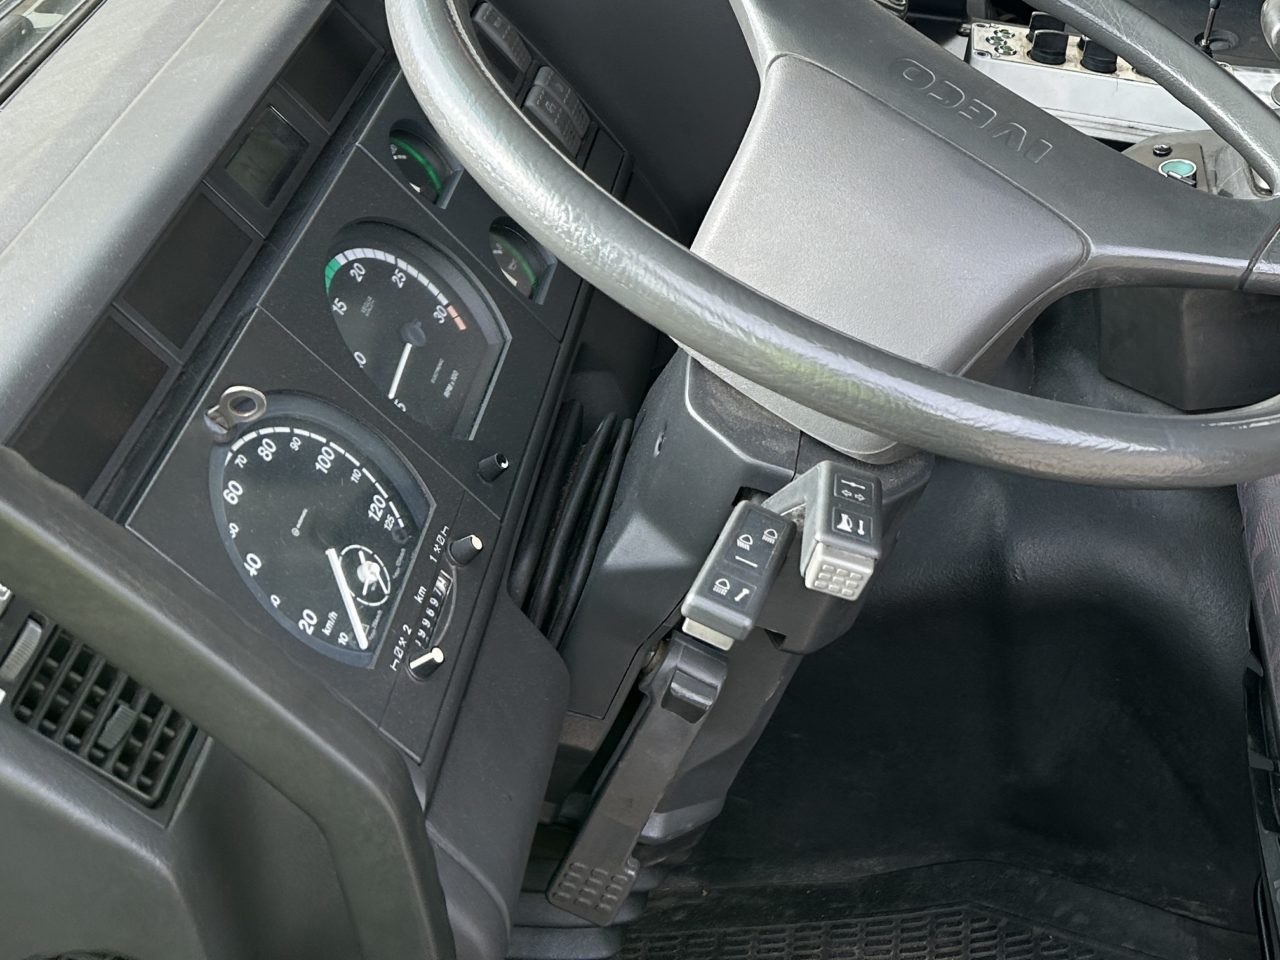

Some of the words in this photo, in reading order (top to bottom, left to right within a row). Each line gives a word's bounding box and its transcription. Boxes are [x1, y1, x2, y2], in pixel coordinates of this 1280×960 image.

[895, 58, 1053, 164] IVECO
[350, 263, 366, 283] 20
[392, 269, 407, 289] 25
[331, 297, 347, 315] 15
[433, 305, 449, 324] 30
[353, 351, 367, 368] 0
[394, 398, 407, 412] 5
[257, 438, 277, 462] 80
[289, 436, 302, 451] 90
[234, 454, 248, 468] 70
[315, 446, 335, 474] 100
[350, 468, 362, 483] 110
[223, 480, 244, 505] 60
[367, 494, 386, 521] 120
[384, 513, 395, 531] 125
[243, 552, 262, 577] 40
[414, 585, 427, 603] km
[298, 608, 318, 635] 20
[321, 611, 338, 636] km/h
[403, 624, 412, 635] 2
[338, 631, 349, 646] 10
